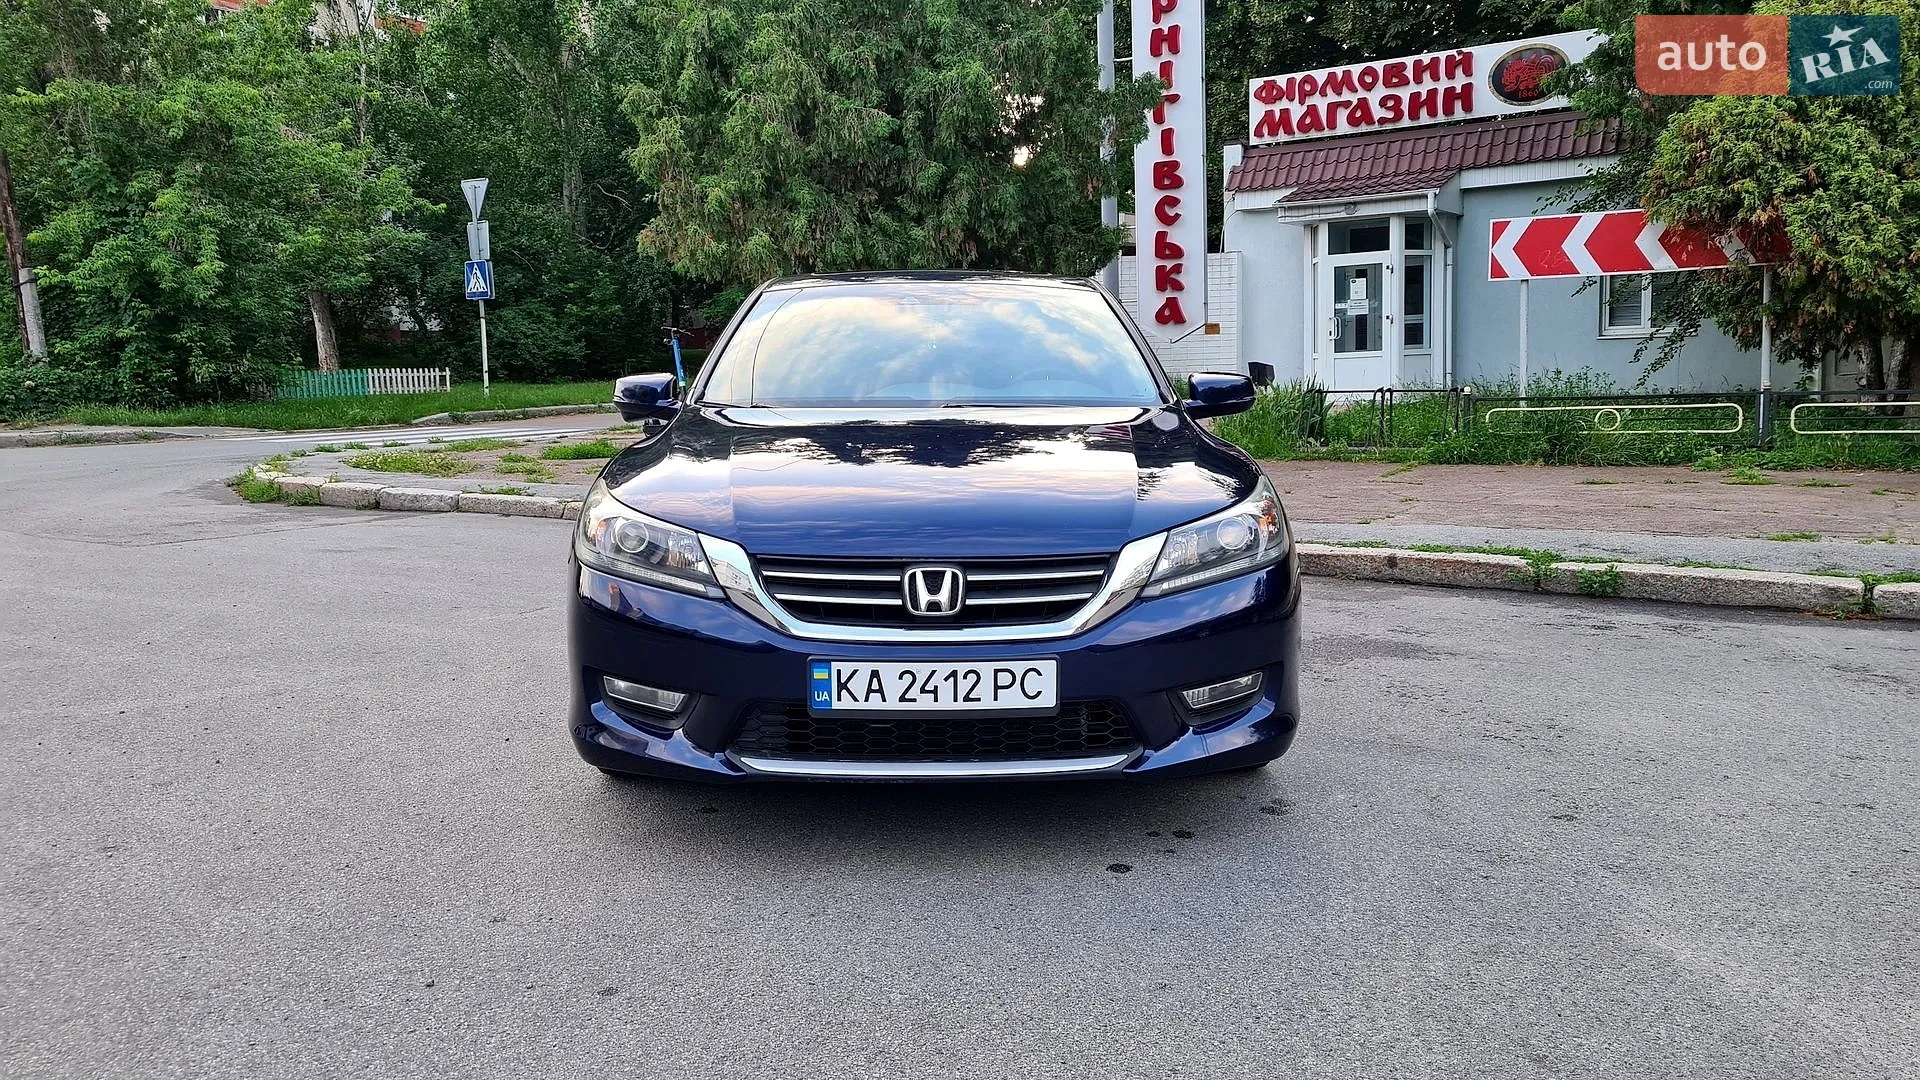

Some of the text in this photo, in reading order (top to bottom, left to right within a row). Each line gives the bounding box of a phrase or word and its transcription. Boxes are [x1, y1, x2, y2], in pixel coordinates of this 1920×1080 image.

[1253, 50, 1473, 105] ФІРМОВИЙ
[1253, 82, 1473, 138] МАГАЗИН
[814, 690, 830, 701] UA
[836, 667, 1043, 703] KA 2412 PC
